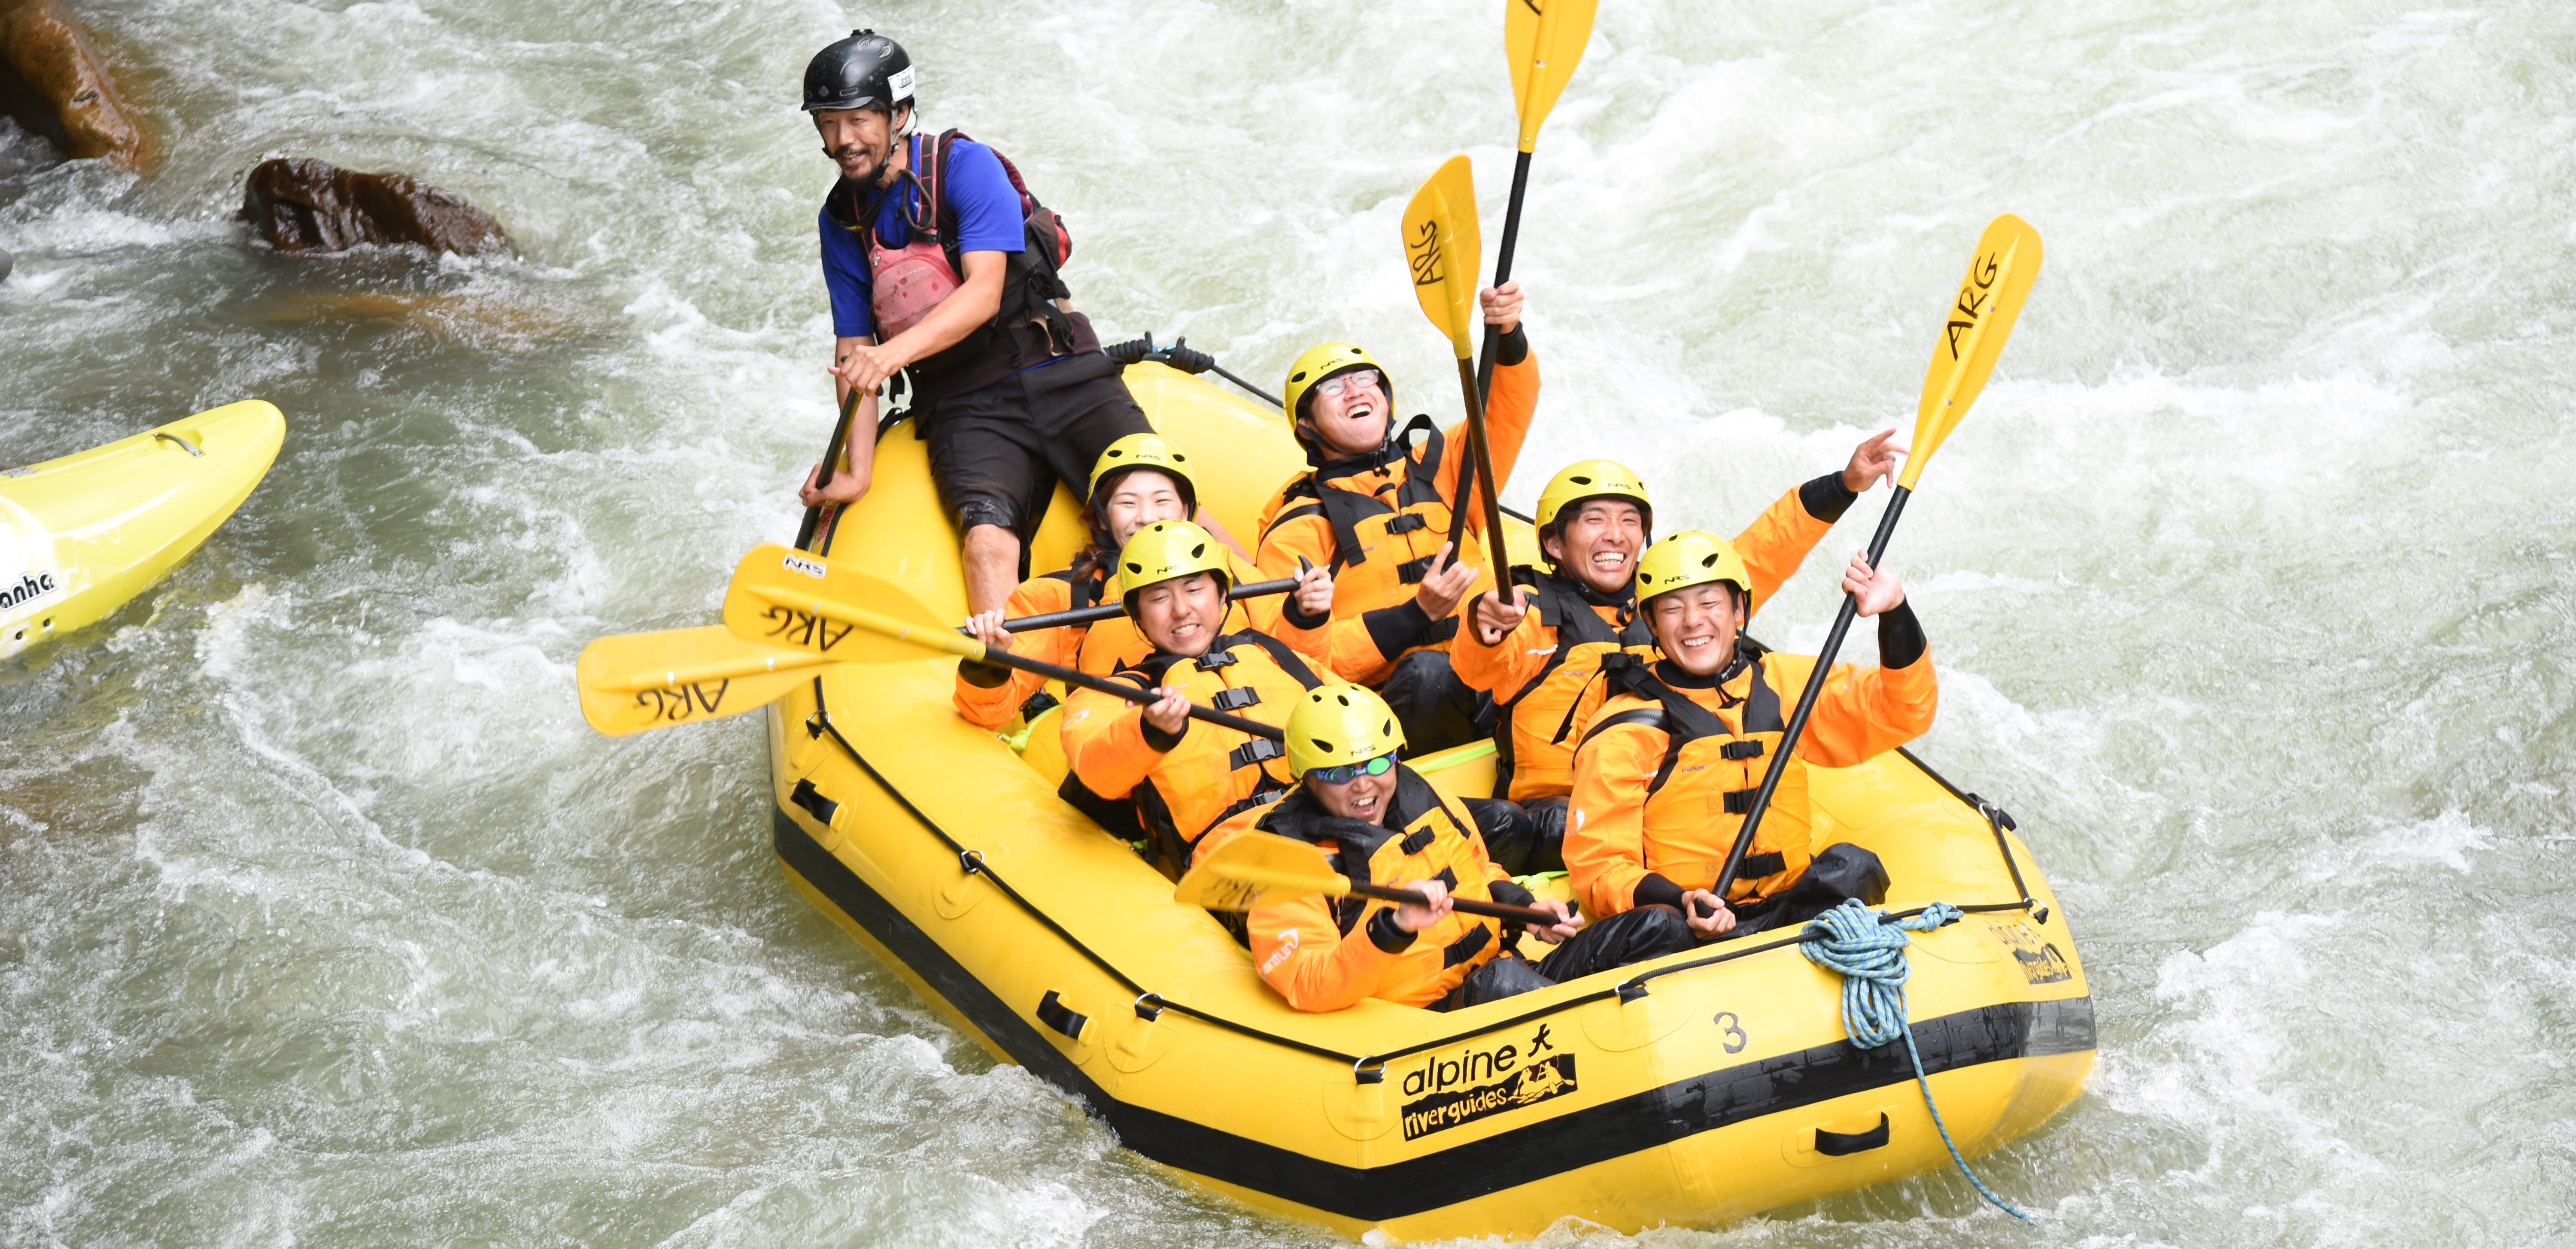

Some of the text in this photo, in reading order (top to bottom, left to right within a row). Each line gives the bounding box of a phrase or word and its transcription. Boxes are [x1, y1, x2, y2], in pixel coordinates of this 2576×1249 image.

[1410, 220, 1444, 285] ARG
[1947, 252, 1997, 361] ARG
[1321, 358, 1343, 370] NRS
[786, 559, 823, 574] NRS
[1157, 564, 1182, 574] NRS
[1664, 574, 1689, 585] NRS
[760, 606, 854, 651] ARG
[633, 679, 729, 725] ARG
[1351, 744, 1376, 756] NRS
[1713, 1012, 1747, 1054] 3
[1403, 1045, 1517, 1097] alpine
